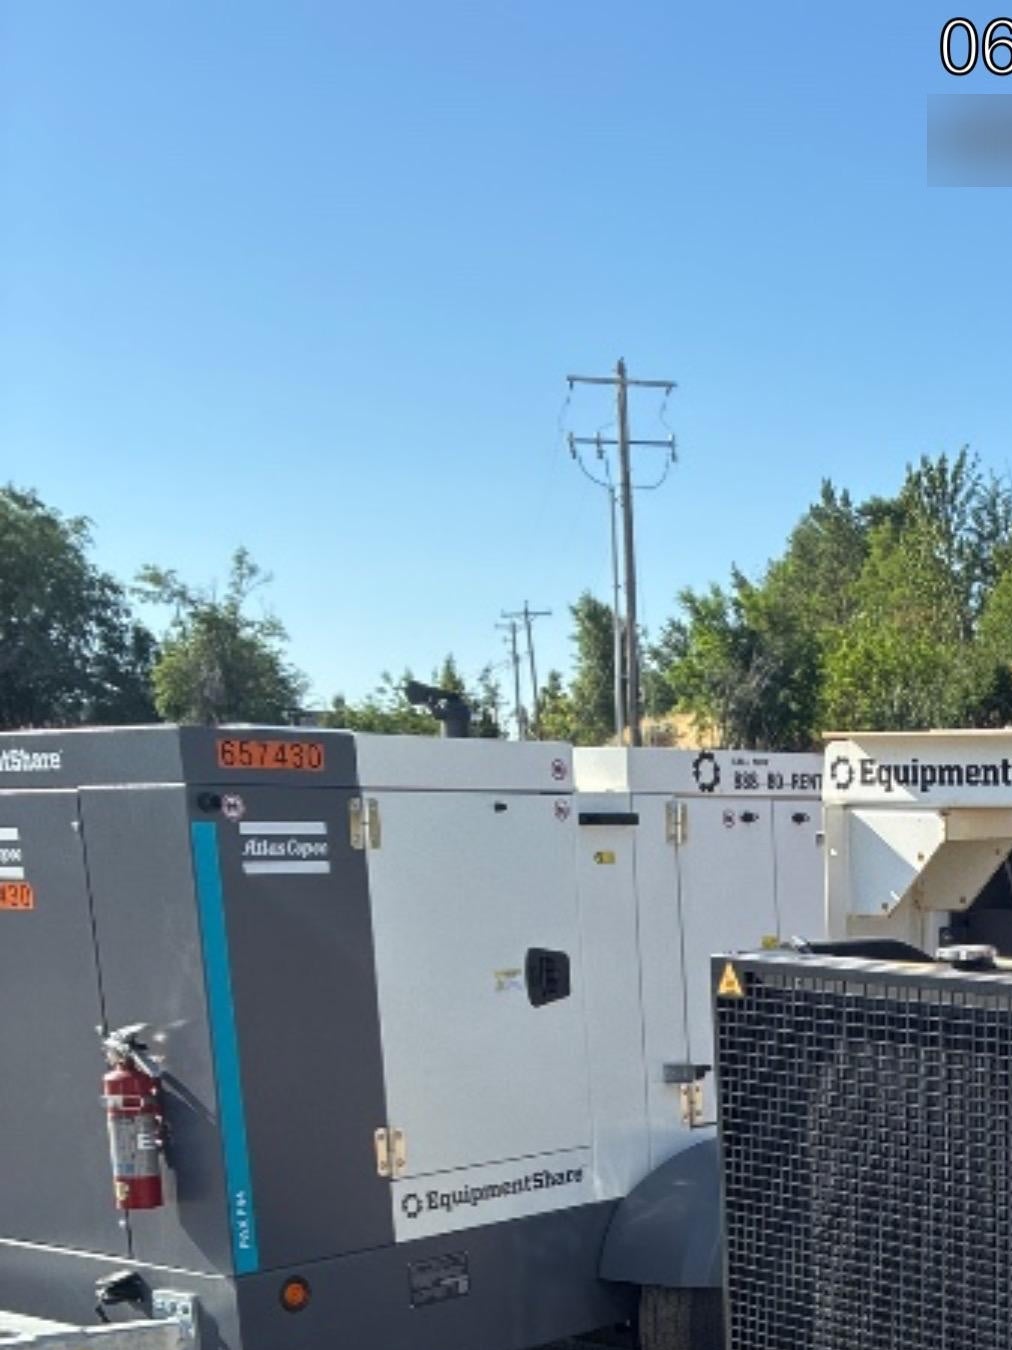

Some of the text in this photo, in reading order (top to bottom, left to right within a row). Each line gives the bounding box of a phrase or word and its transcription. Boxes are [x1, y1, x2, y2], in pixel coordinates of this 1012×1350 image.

[0, 749, 62, 772] tShare
[220, 740, 323, 769] 657430
[242, 839, 285, 856] Atlas
[426, 1168, 583, 1212] EquipmentShare
